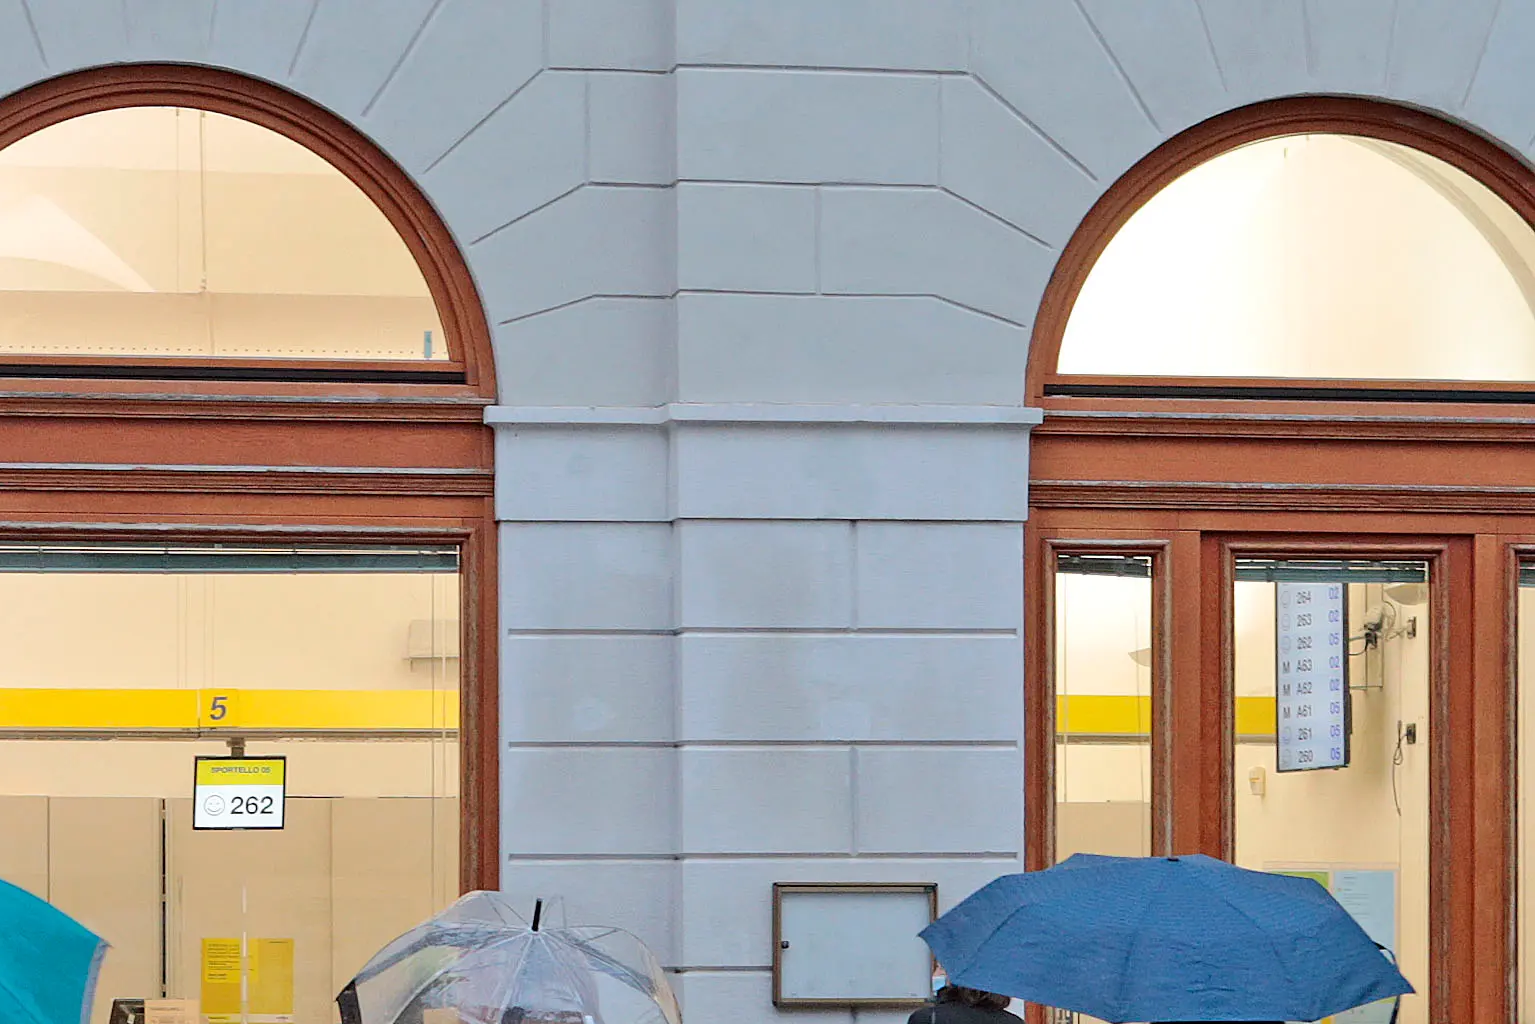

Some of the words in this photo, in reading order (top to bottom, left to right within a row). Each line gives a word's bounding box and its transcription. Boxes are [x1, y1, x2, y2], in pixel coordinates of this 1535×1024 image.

[1329, 586, 1340, 600] 02
[1328, 609, 1340, 623] 02
[1282, 660, 1291, 674] M
[1329, 655, 1340, 669] 02
[1283, 683, 1291, 697] M
[210, 696, 228, 720] 5
[1283, 705, 1291, 719] M
[211, 766, 259, 774] SPORTELLO
[230, 796, 274, 815] 262
